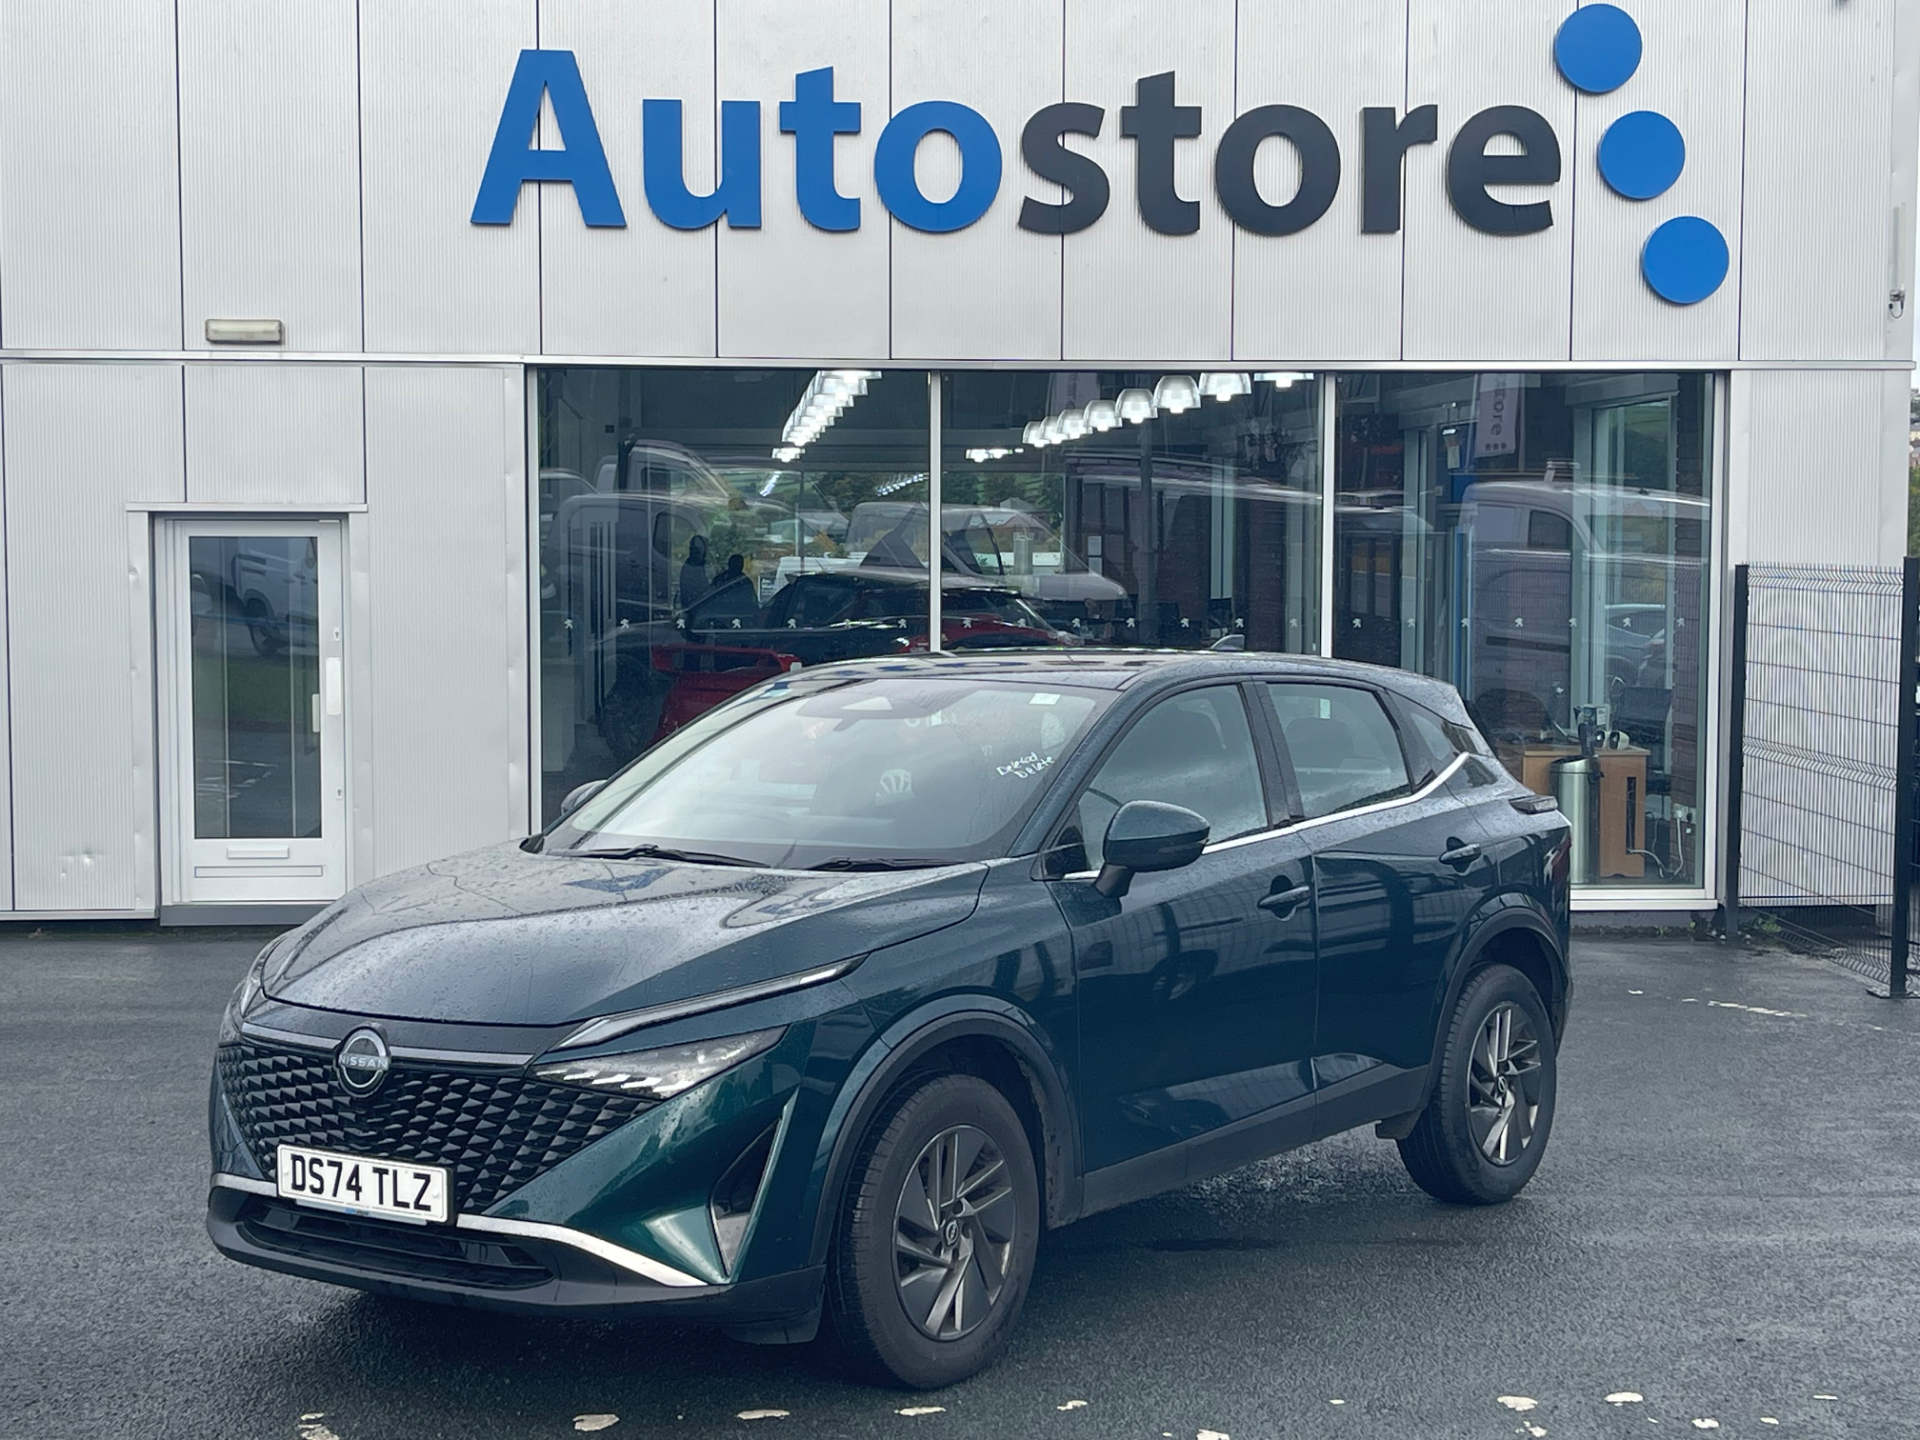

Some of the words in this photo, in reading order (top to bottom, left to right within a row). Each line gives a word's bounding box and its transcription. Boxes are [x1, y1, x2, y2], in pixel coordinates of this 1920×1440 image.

[470, 48, 1562, 236] Autostore
[338, 1054, 389, 1068] NISSAN
[290, 1153, 363, 1202] DS74
[372, 1167, 432, 1212] TLZ
